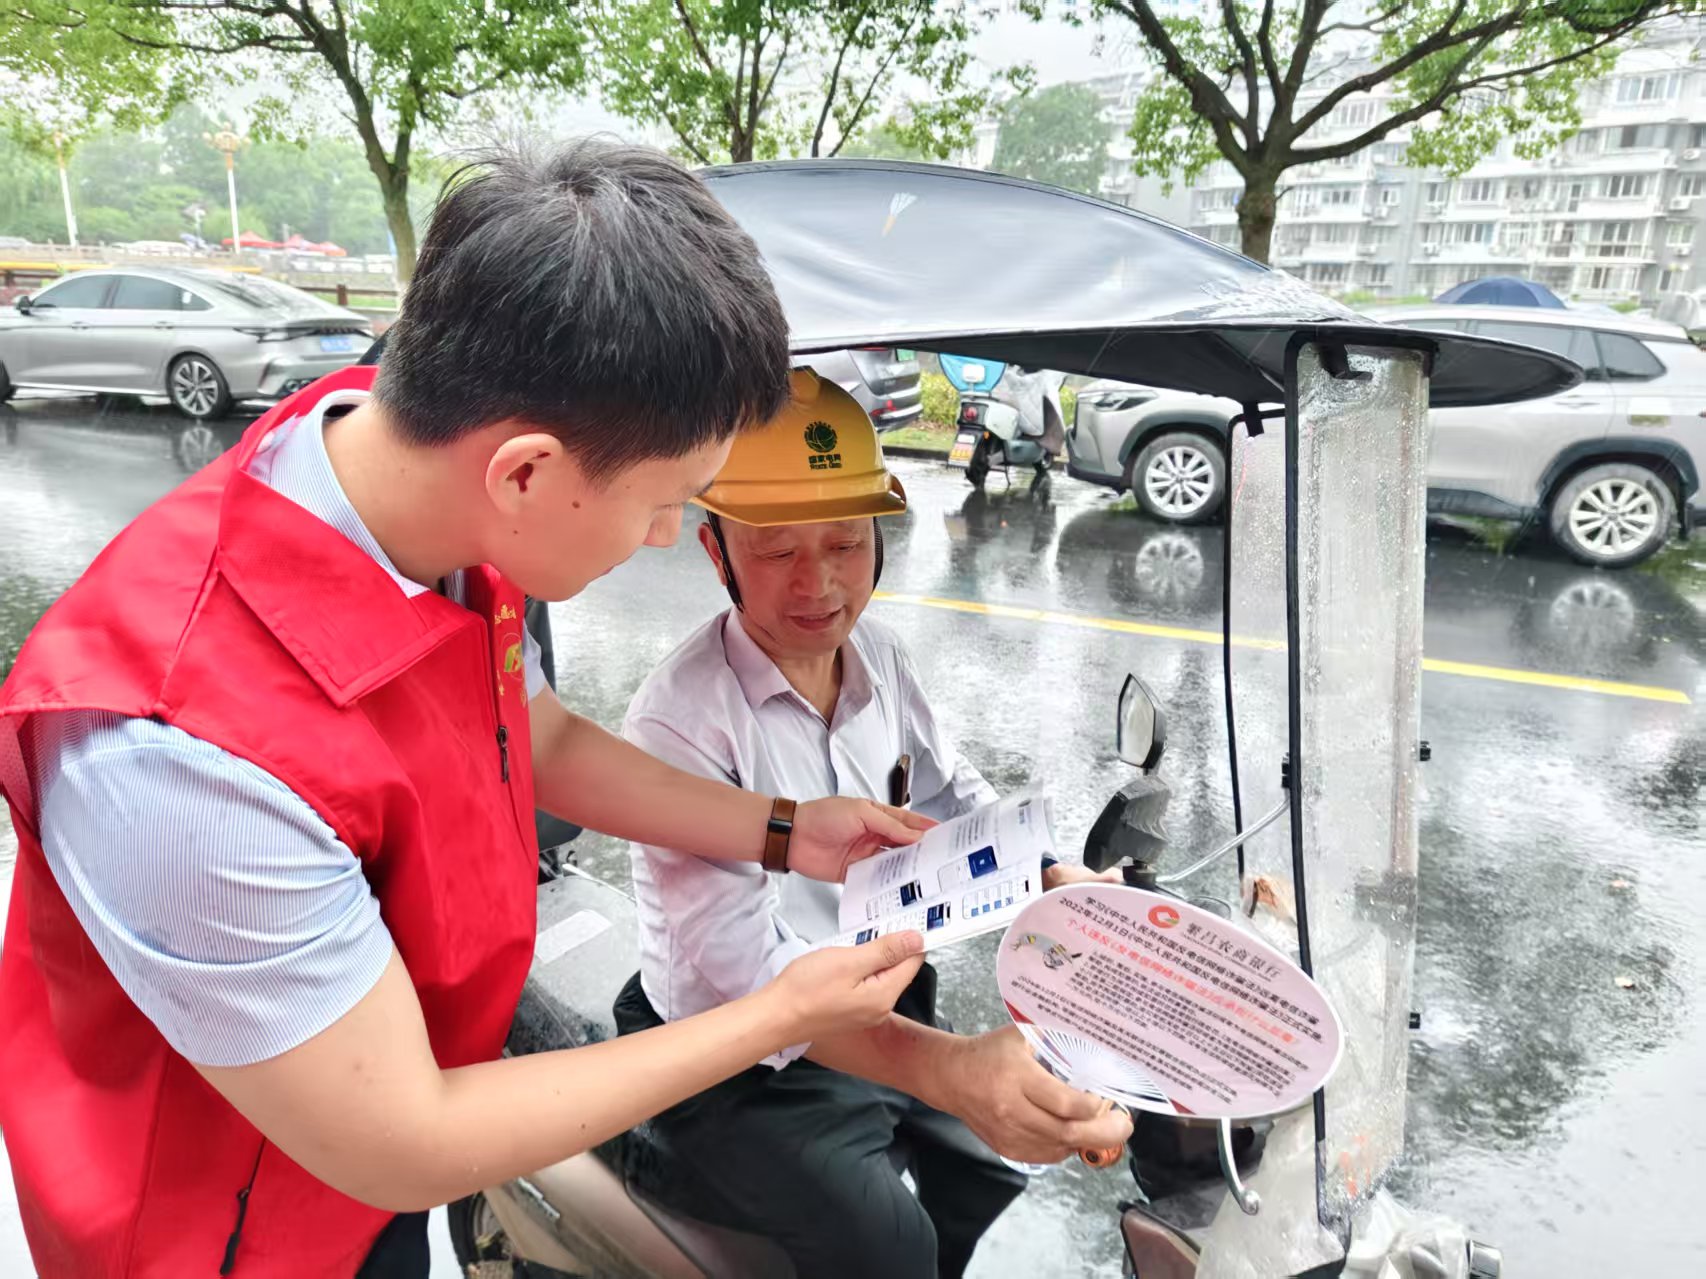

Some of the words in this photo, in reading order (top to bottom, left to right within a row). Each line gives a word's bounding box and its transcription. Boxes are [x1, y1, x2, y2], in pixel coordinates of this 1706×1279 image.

[1187, 922, 1282, 978] 繁昌农商银行
